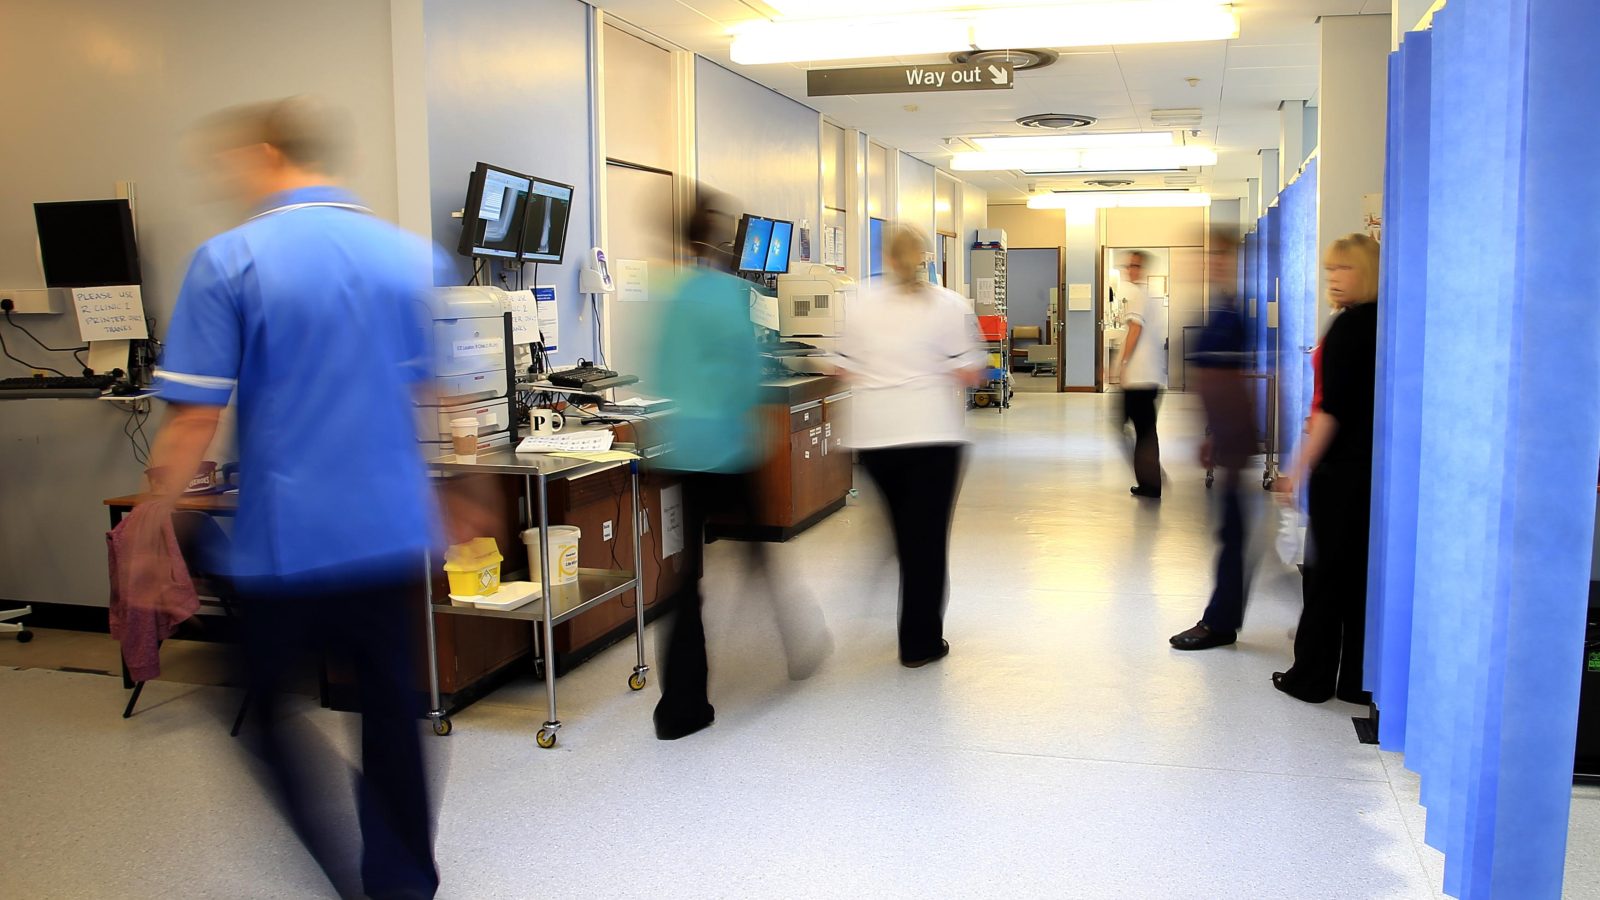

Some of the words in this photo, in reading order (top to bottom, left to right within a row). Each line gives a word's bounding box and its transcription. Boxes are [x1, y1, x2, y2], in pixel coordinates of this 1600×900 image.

[906, 69, 945, 87] Way
[951, 66, 981, 83] out
[77, 292, 112, 301] PLEASE
[86, 315, 127, 325] PRINTER
[534, 416, 545, 431] P
